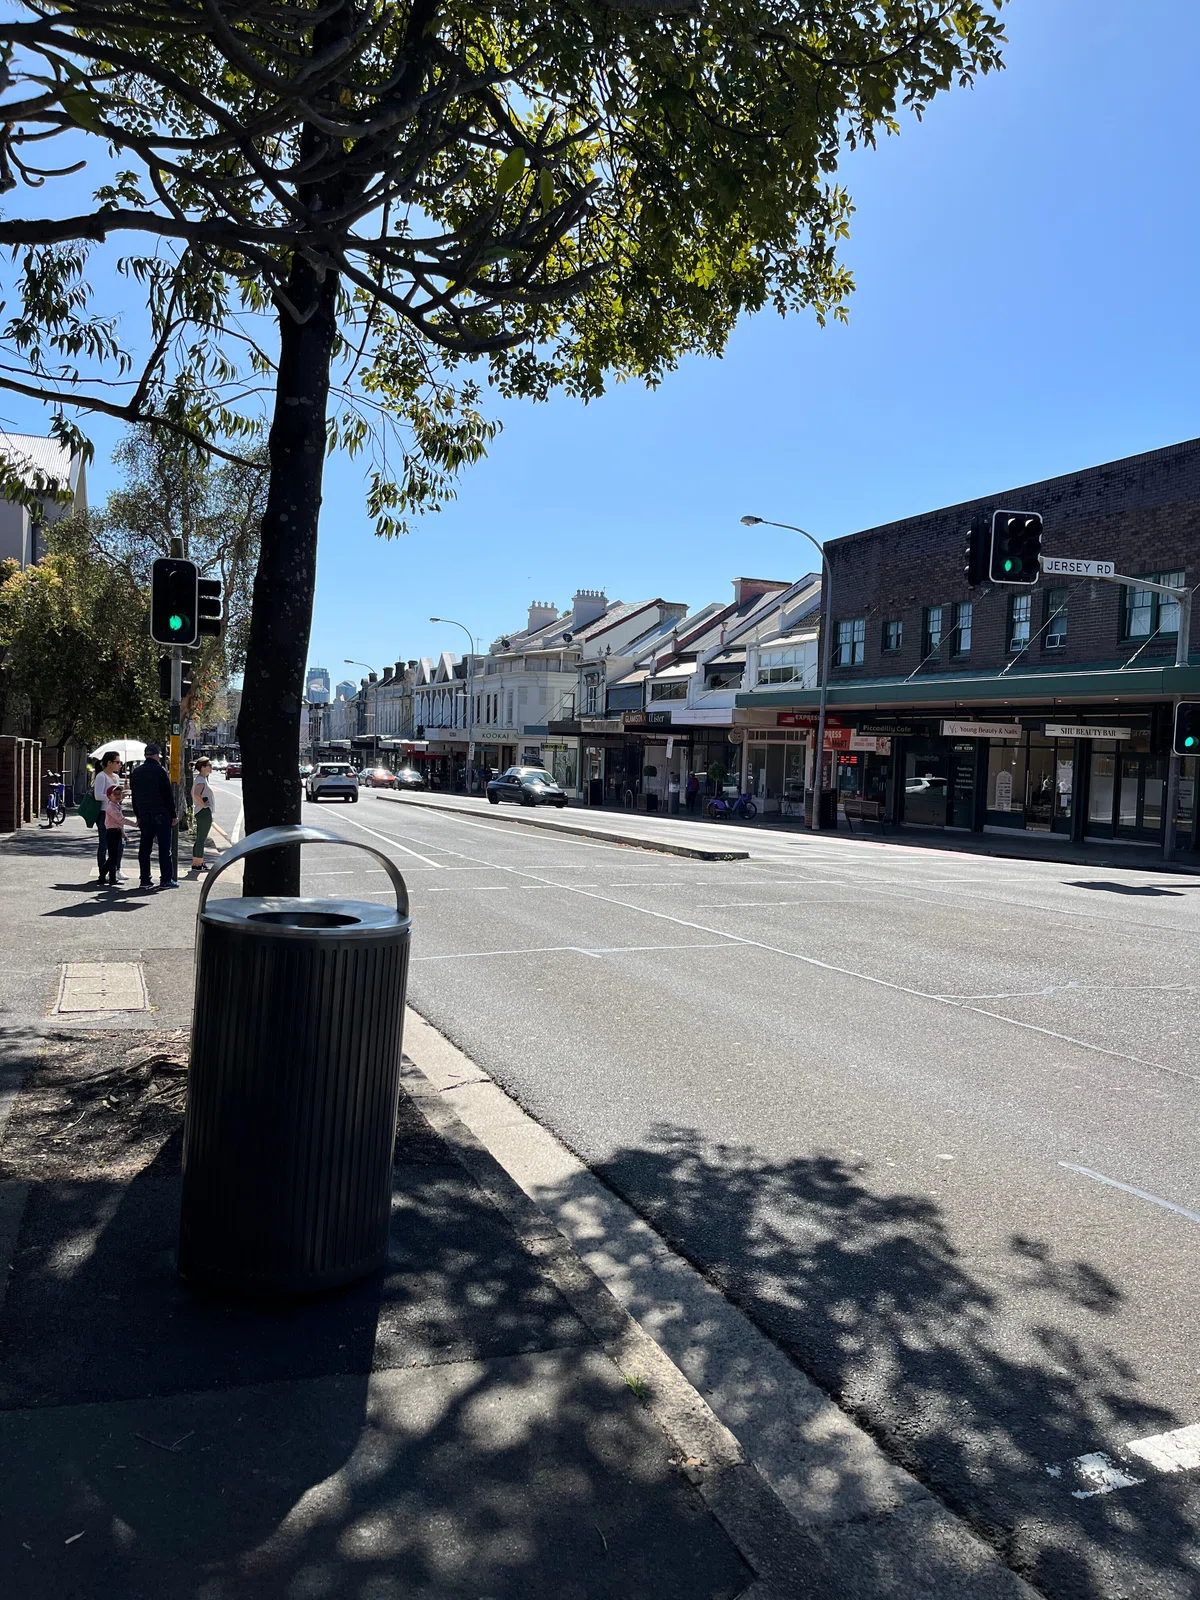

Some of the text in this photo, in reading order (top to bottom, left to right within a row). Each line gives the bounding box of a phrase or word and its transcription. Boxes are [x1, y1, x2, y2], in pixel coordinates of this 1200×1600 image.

[1047, 561, 1111, 574] JERSEY RD
[863, 724, 896, 733] Piccadilly
[960, 726, 977, 734] Young
[979, 727, 997, 735] Beauty
[1060, 727, 1116, 737] SHU BEAUTY BAR
